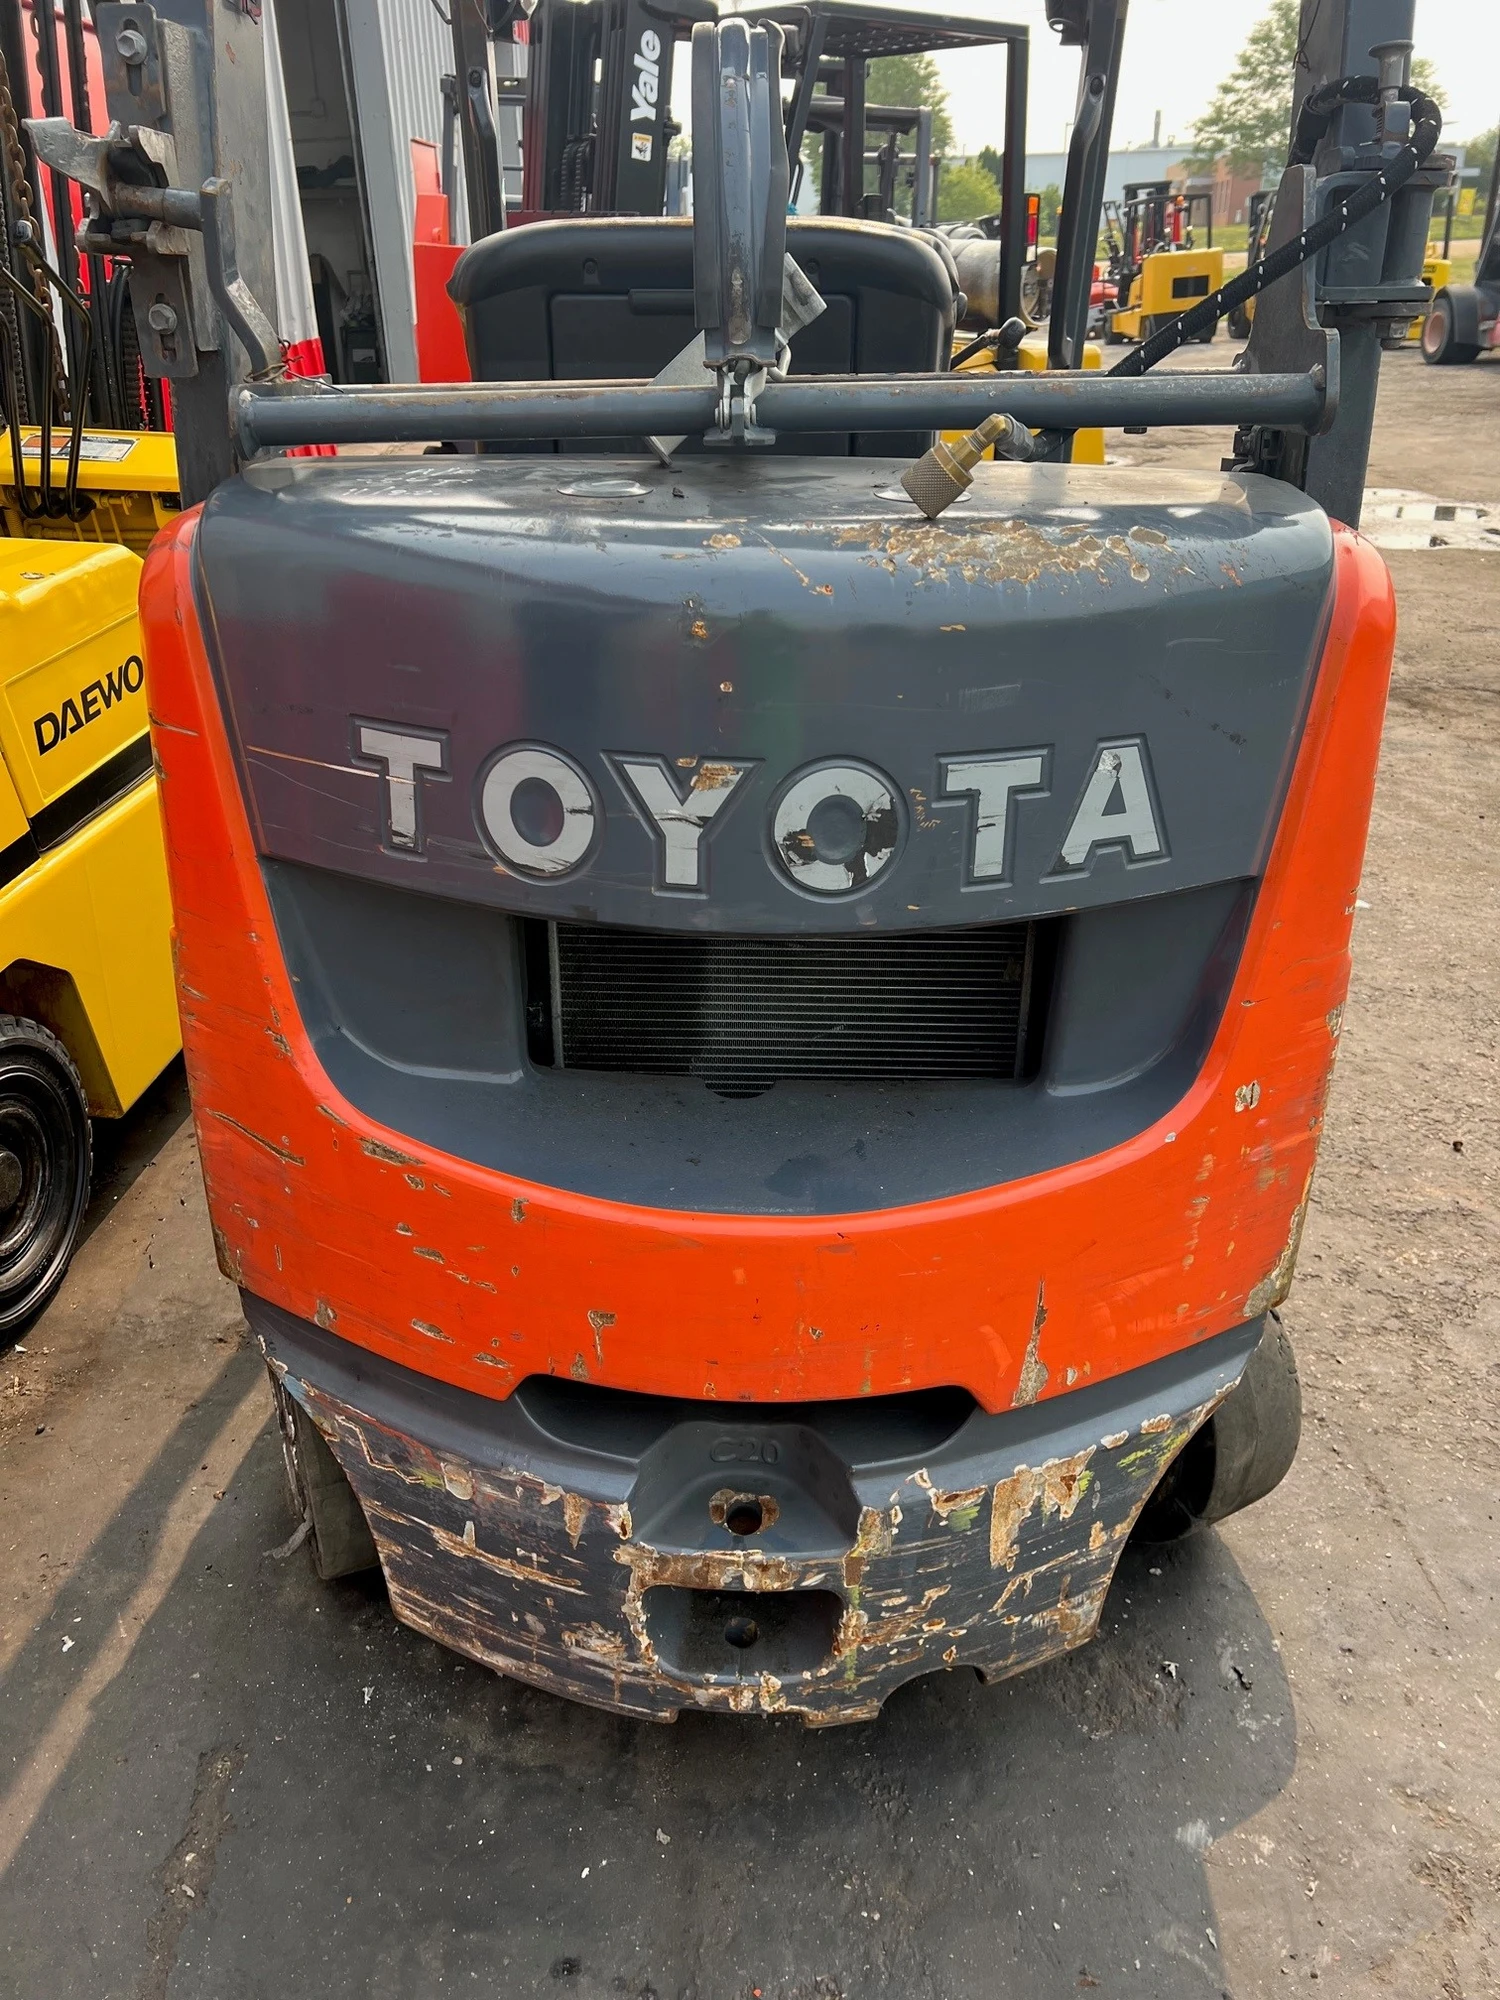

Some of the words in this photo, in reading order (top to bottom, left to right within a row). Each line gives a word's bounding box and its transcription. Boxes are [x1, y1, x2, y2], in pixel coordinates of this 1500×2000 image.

[630, 29, 660, 121] Yale
[354, 719, 1167, 897] TOYOTA
[709, 1436, 780, 1465] C20
